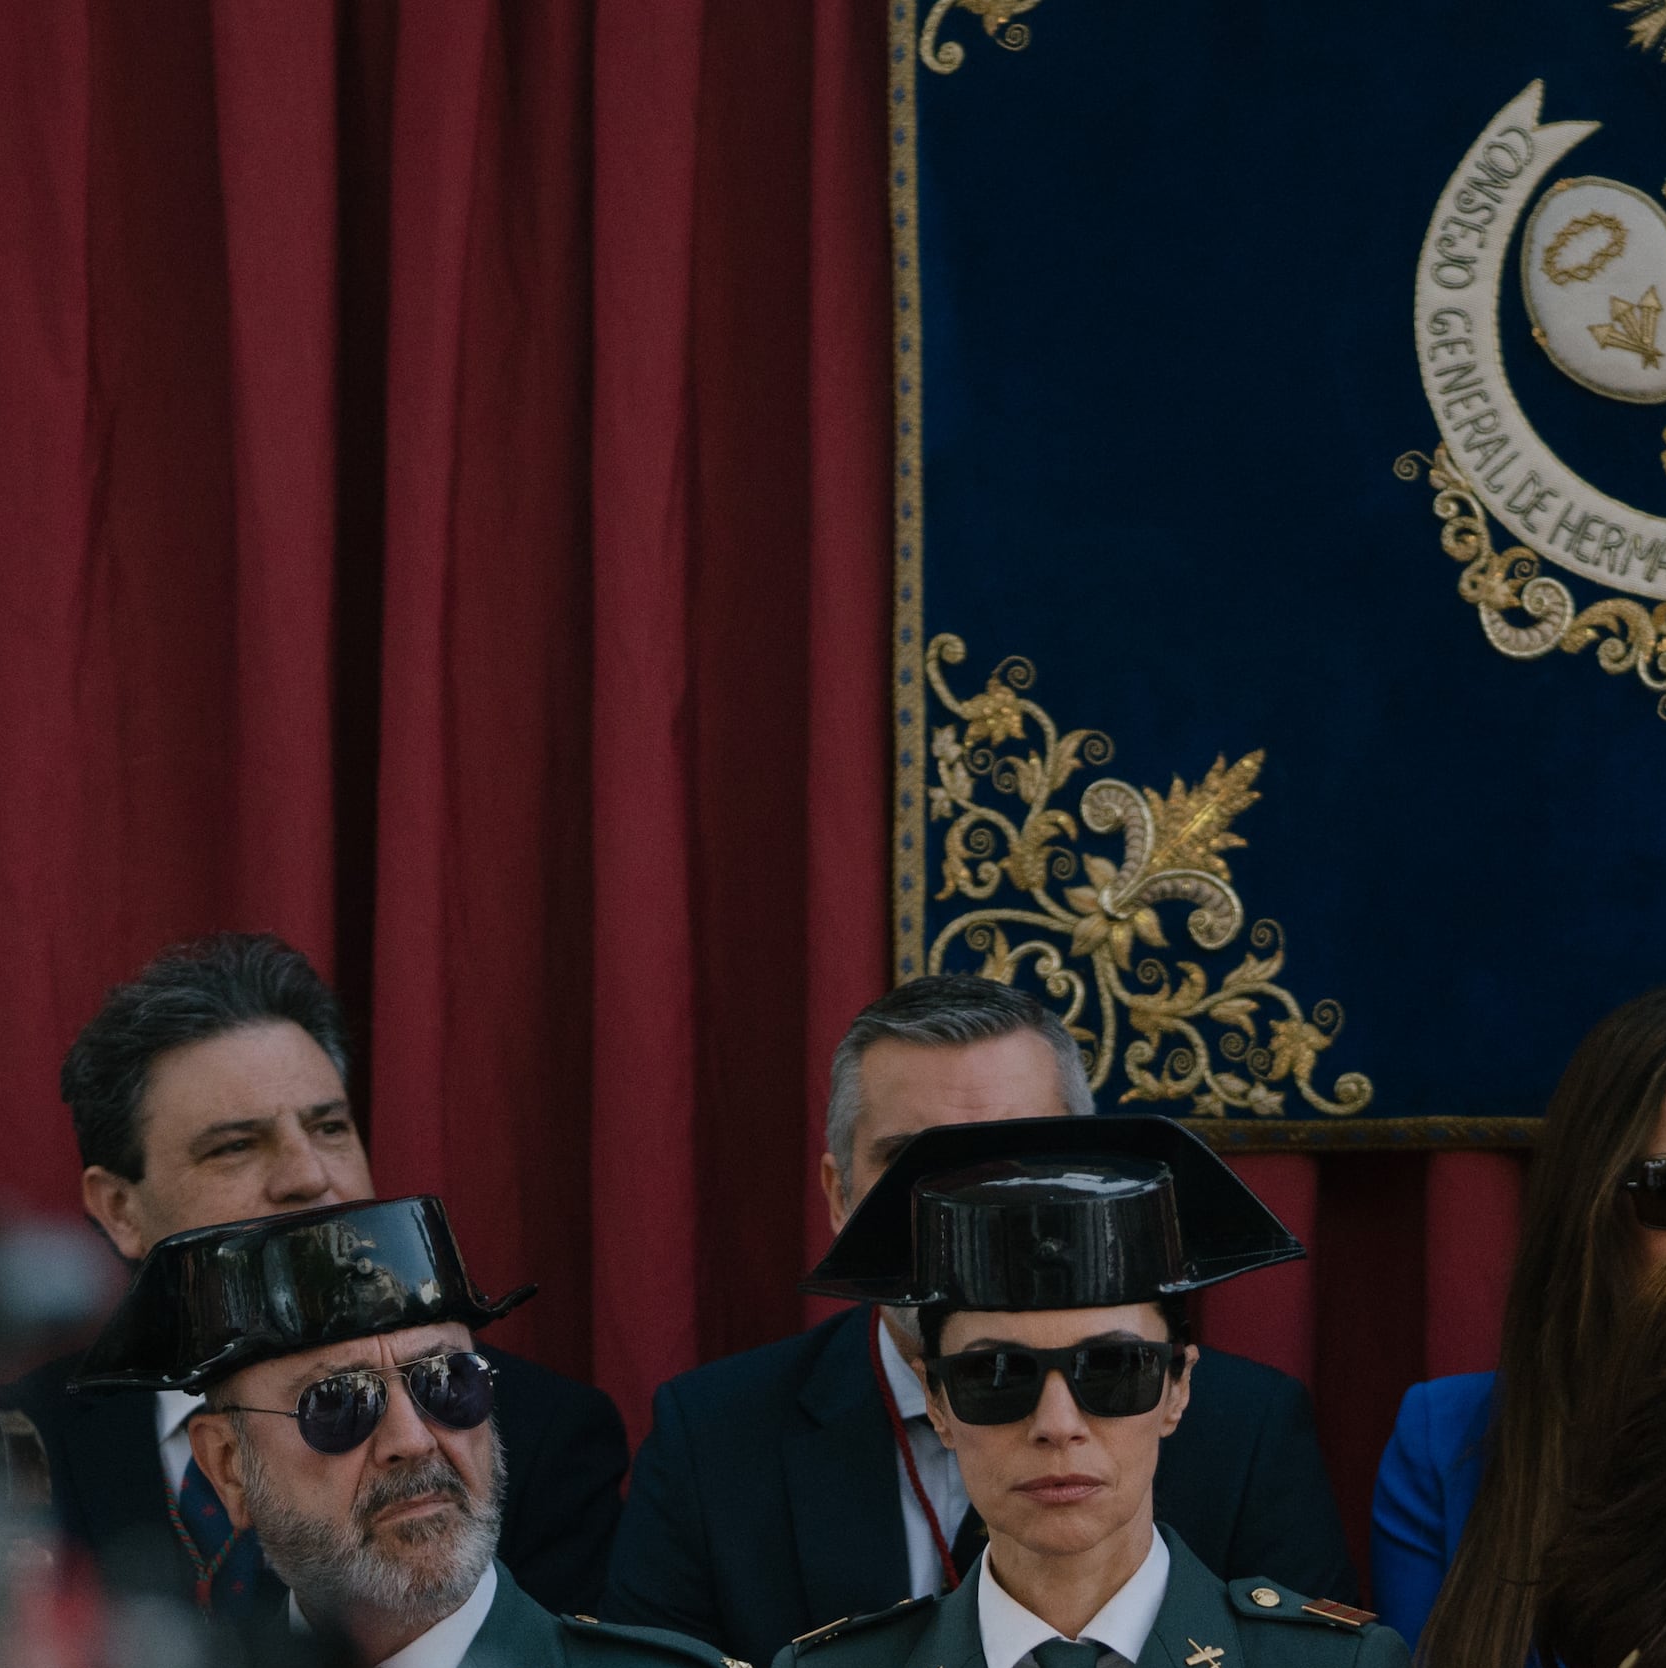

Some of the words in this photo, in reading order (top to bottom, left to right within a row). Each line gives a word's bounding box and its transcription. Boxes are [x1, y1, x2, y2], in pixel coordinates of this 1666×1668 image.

[1431, 125, 1534, 289] CONSEJO
[1428, 306, 1520, 494] GENERAL
[1504, 470, 1559, 534] DE
